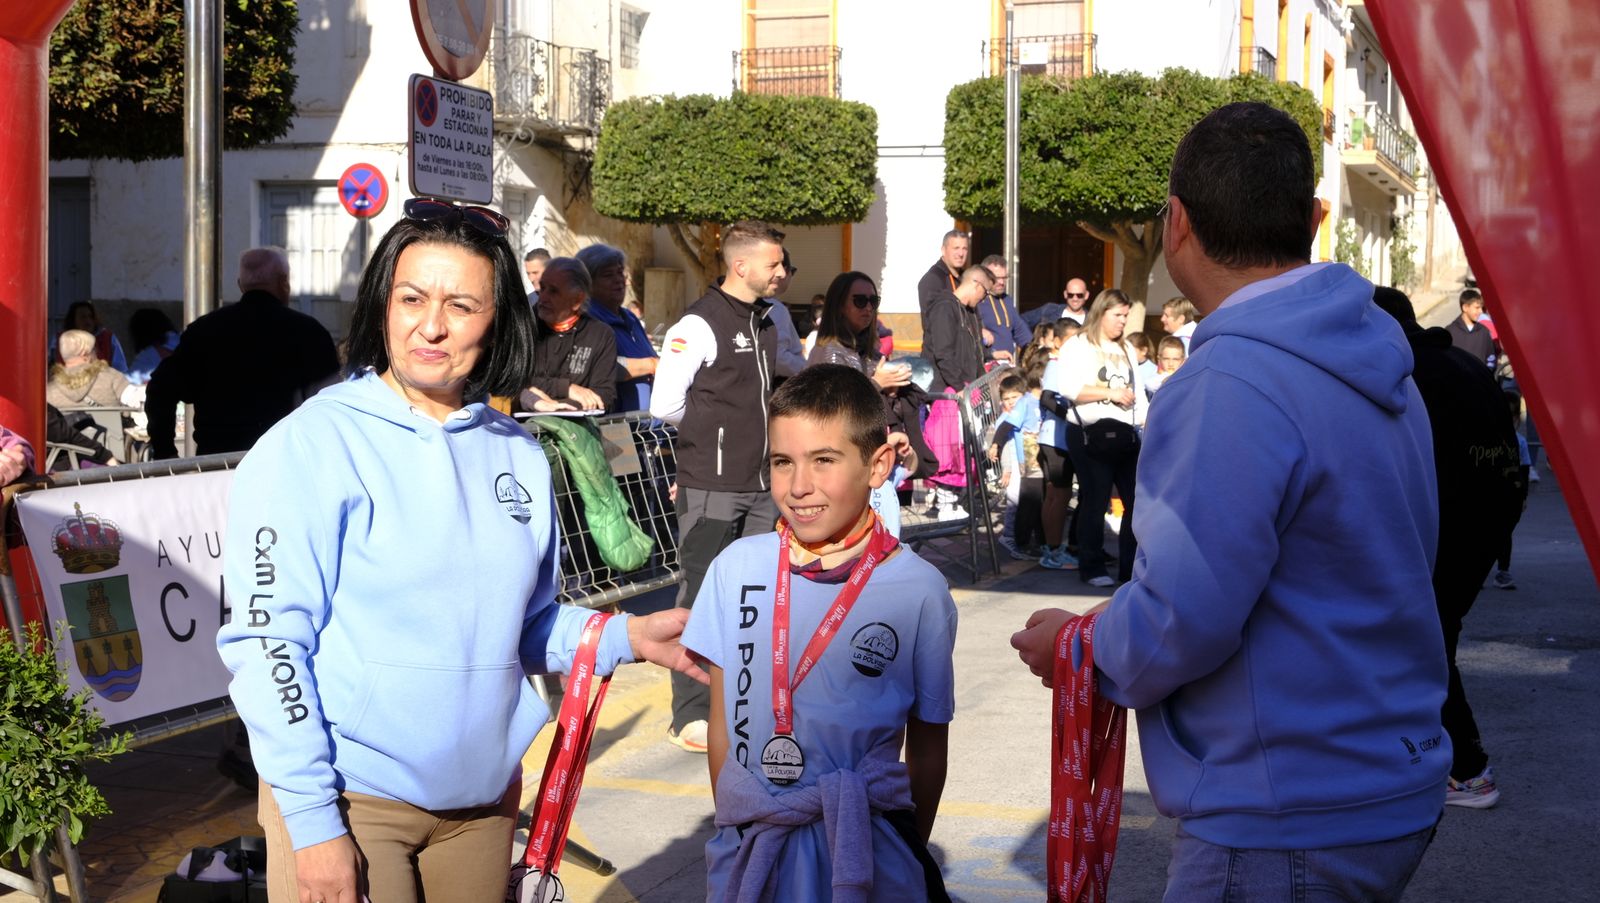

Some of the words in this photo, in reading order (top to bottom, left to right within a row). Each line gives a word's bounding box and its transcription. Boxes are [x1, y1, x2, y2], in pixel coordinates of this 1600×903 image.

[440, 86, 492, 112] PROHIBIDO
[451, 107, 476, 122] PARAR
[477, 113, 482, 122] Y
[444, 118, 489, 138] ESTACIONAR
[415, 131, 426, 145] EN
[429, 134, 452, 149] TODA
[454, 140, 465, 152] LA
[467, 142, 492, 157] PLAZA
[417, 161, 432, 173] hasta
[433, 165, 439, 174] el
[439, 166, 455, 177] Lunes
[423, 153, 430, 162] de
[248, 594, 274, 627] LA
[740, 585, 766, 629] LA
[734, 643, 756, 772] POLVO
